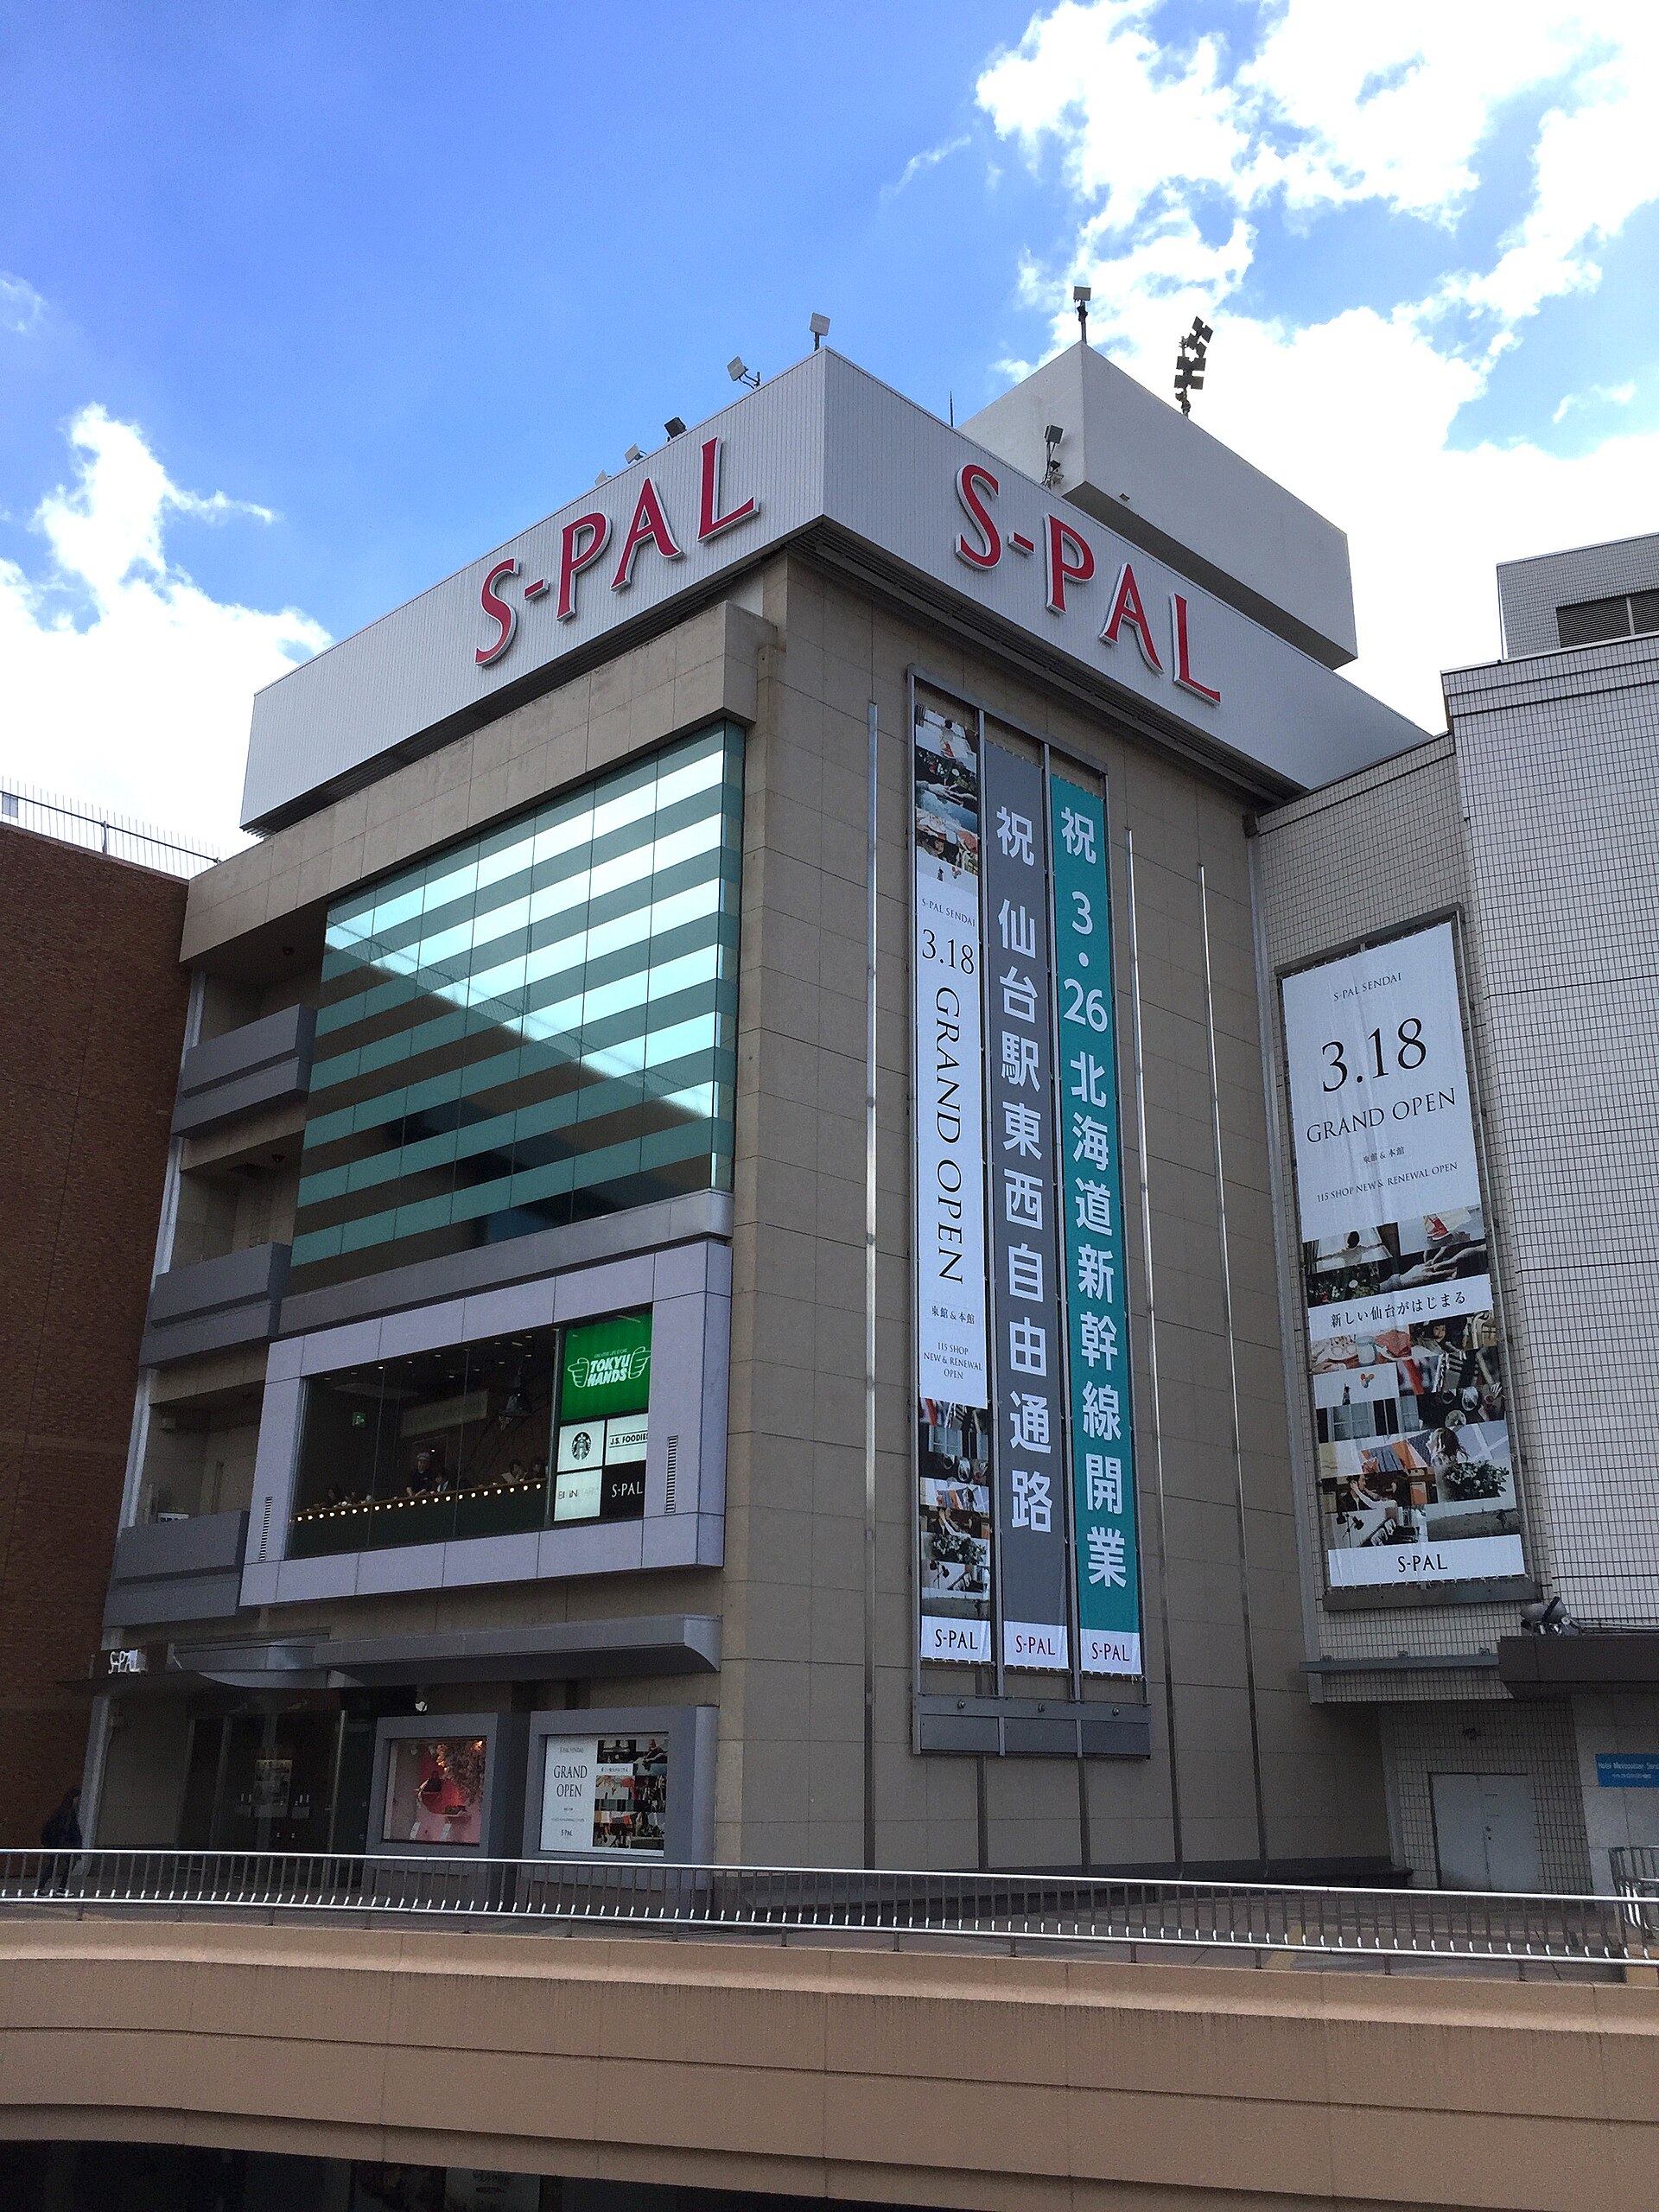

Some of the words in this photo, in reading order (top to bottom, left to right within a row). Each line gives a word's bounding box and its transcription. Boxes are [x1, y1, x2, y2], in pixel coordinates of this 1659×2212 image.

[475, 436, 760, 666] S-PAL
[956, 463, 1221, 703] S-PAL
[996, 805, 1036, 867] 祝
[1061, 806, 1096, 864] 祝
[922, 899, 944, 914] S-PAL
[946, 907, 975, 927] SENDAI
[922, 929, 975, 975] 3.18
[1333, 986, 1359, 1001] S-PAL
[1362, 972, 1402, 992] SENDAI
[935, 987, 961, 1144] GRAND
[1321, 1017, 1427, 1093] 3.18
[1306, 1107, 1385, 1143] GRAND
[1392, 1087, 1457, 1121] OPEN
[1317, 1192, 1329, 1202] 115
[1331, 1186, 1354, 1198] SHOP
[1356, 1181, 1376, 1193] NEW
[1377, 1179, 1384, 1187] &
[1387, 1168, 1430, 1185] RENEWAL
[1432, 1161, 1458, 1175] OPEN
[937, 1159, 963, 1284] OPEN
[998, 899, 1052, 1534] 仙台駅東西自由通路
[950, 1311, 957, 1320] &
[1331, 1290, 1465, 1328] 新しい仙台がはじまる
[924, 1352, 941, 1362] NEW
[950, 1357, 982, 1371] RENEWAL
[938, 1342, 948, 1351] 115
[950, 1344, 969, 1355] SHOP
[587, 1368, 627, 1387] HANDS
[590, 1354, 631, 1373] TOKYU
[944, 1369, 963, 1379] OPEN
[611, 1481, 643, 1498] S-PAL
[1398, 1554, 1448, 1573] S-PAL
[935, 1629, 978, 1649] S-PAL
[1016, 1635, 1056, 1656] S-PAL
[1092, 1643, 1130, 1662] S-PAL
[553, 1765, 588, 1779] GRAND
[556, 1783, 582, 1797] OPEN
